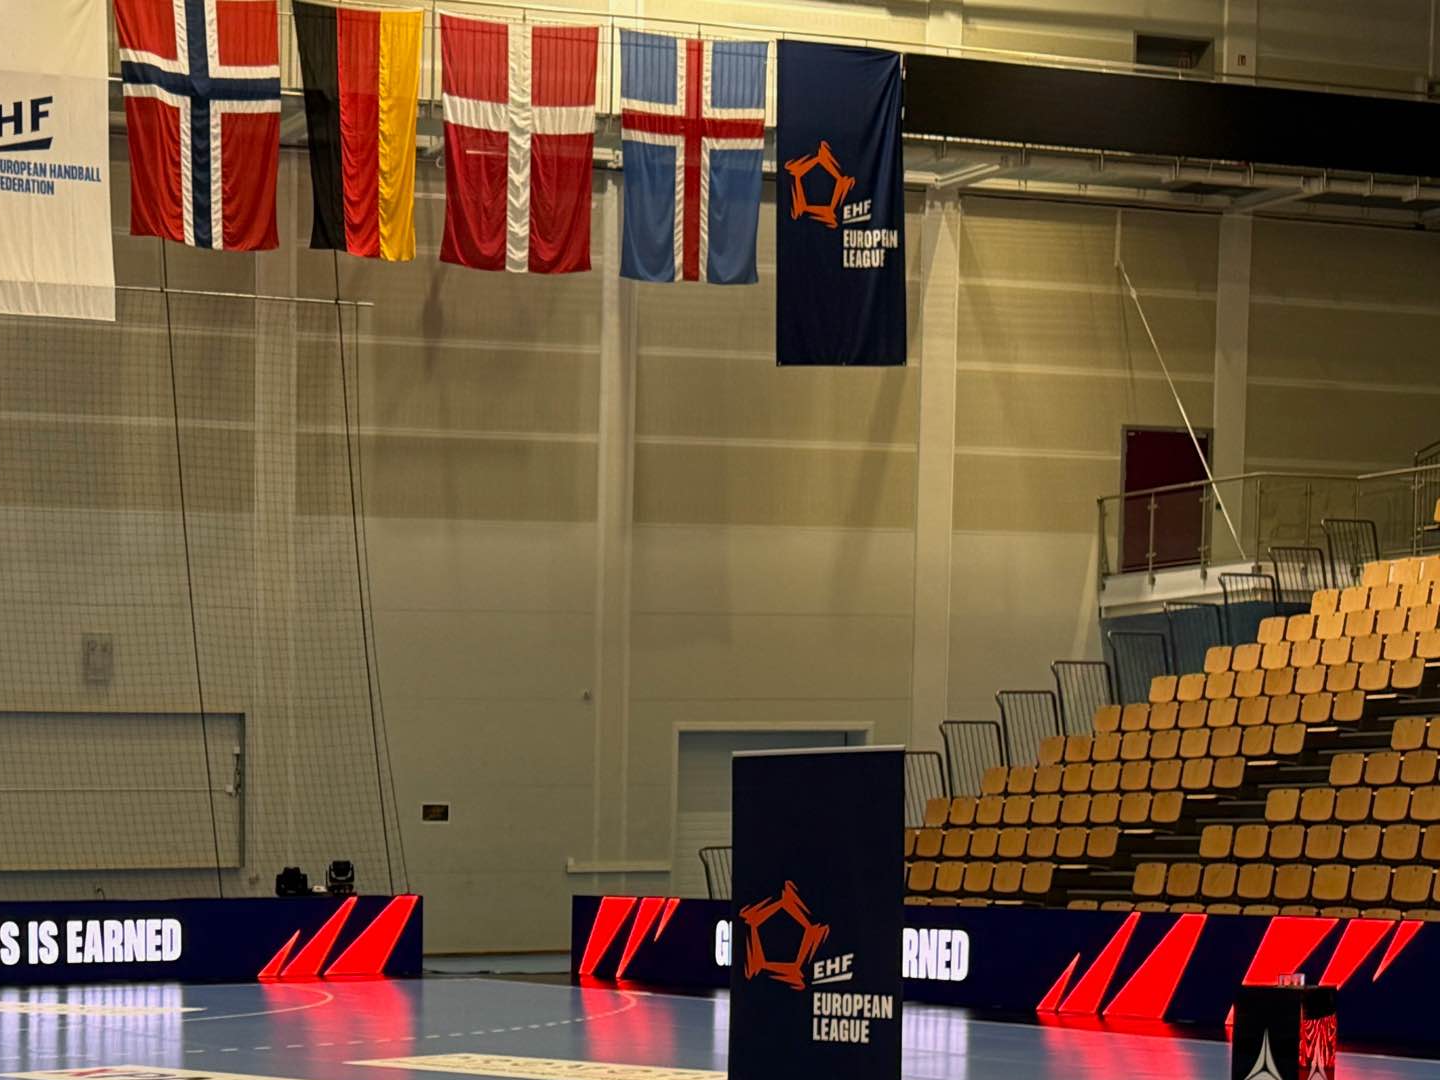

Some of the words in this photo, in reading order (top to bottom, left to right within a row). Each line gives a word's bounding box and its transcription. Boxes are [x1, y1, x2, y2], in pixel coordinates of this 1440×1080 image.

[49, 164, 101, 183] HANDBALL
[843, 199, 871, 219] EHF
[28, 920, 59, 965] IS
[66, 918, 182, 964] EARNED
[902, 927, 970, 982] RNED
[813, 953, 854, 979] EHF
[812, 992, 893, 1019] EUROPEAN
[812, 1017, 870, 1043] LEAGUE
